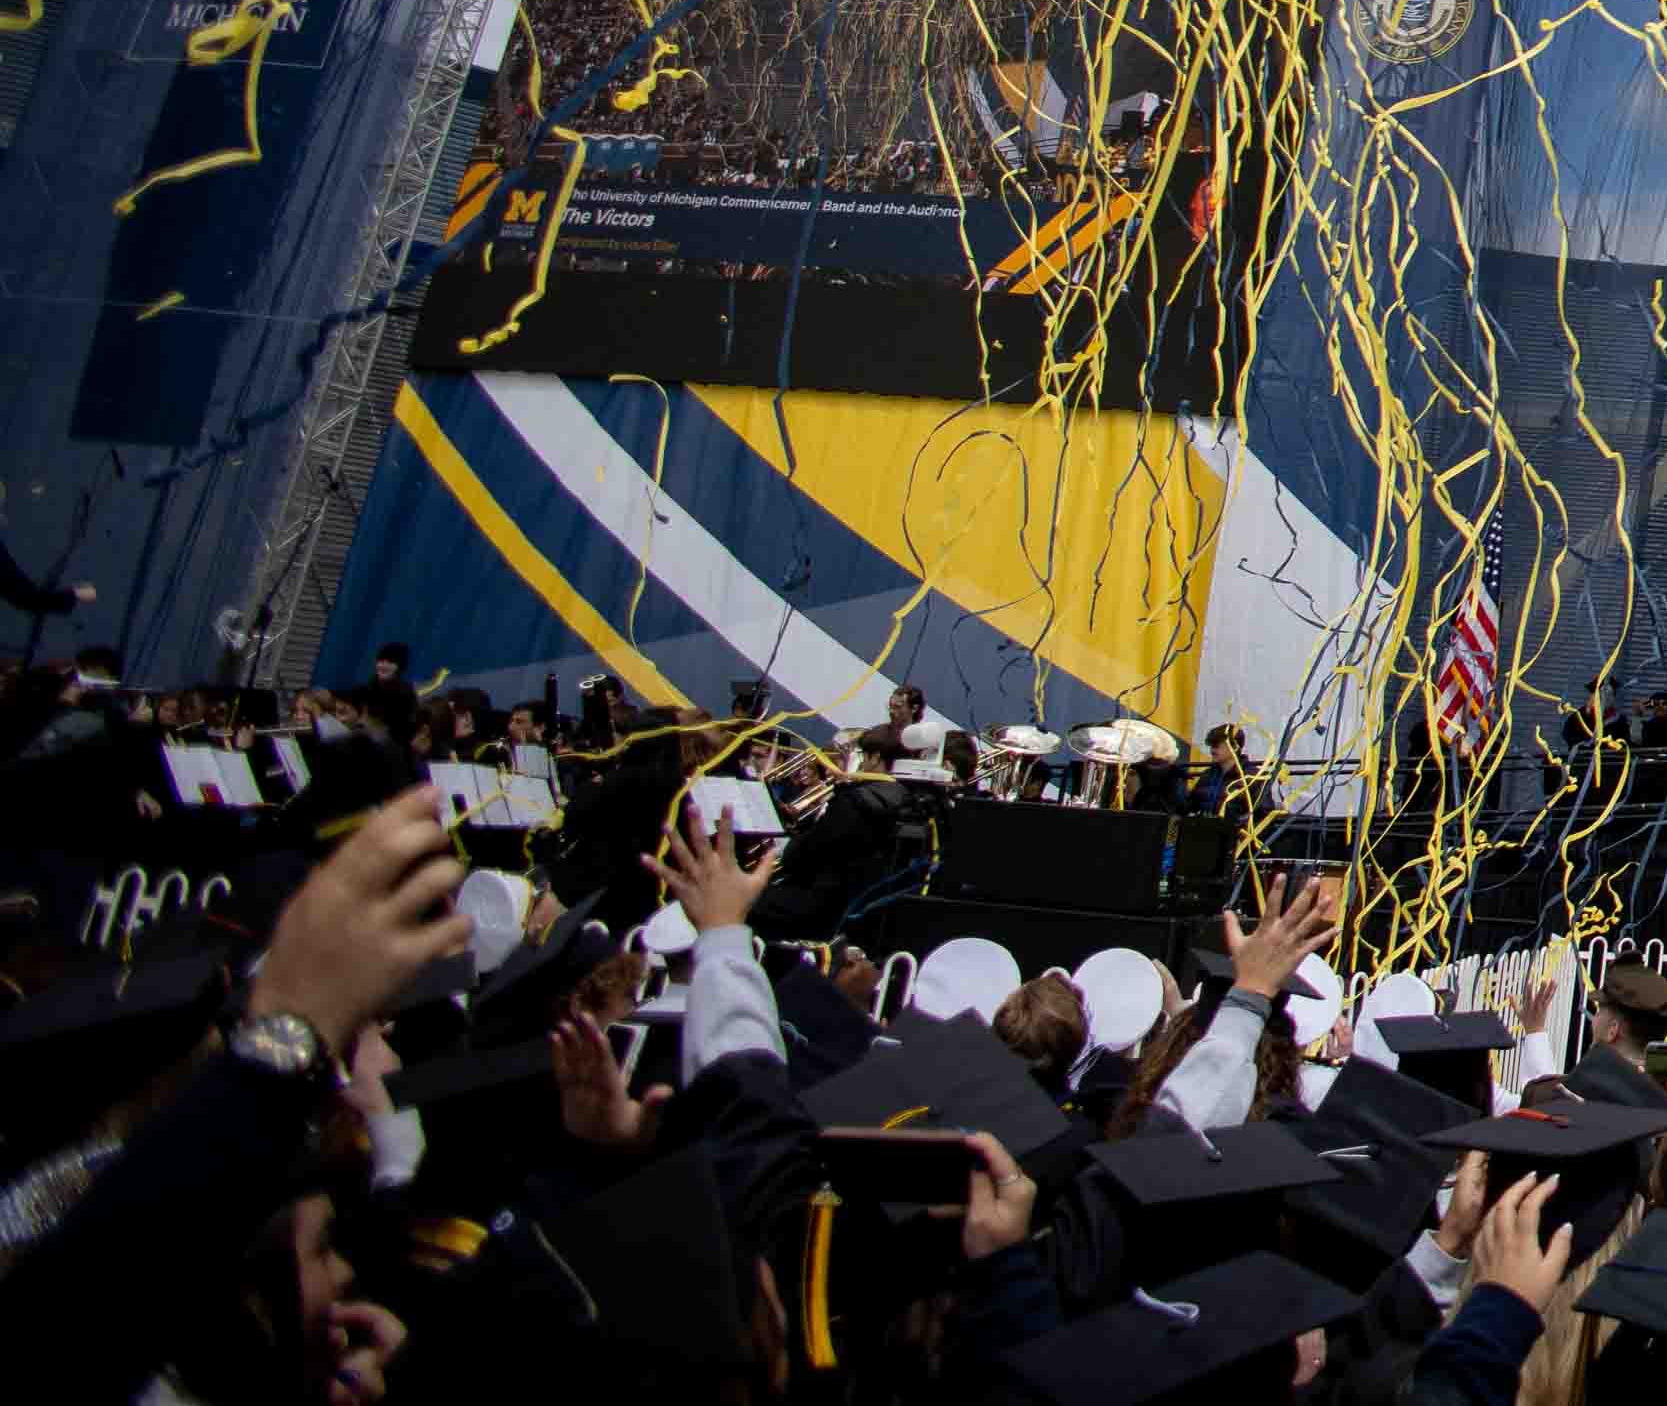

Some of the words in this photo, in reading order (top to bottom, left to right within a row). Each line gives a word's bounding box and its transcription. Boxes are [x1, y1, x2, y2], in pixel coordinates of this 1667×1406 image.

[165, 1, 308, 32] MICHAN
[503, 190, 547, 223] M
[566, 188, 589, 201] he
[590, 189, 645, 206] University
[649, 193, 664, 203] of
[665, 193, 717, 207] Michigan
[720, 195, 819, 211] Commenceme
[822, 200, 854, 212] Band
[856, 201, 882, 214] and
[884, 202, 904, 215] the
[595, 208, 656, 227] Victors
